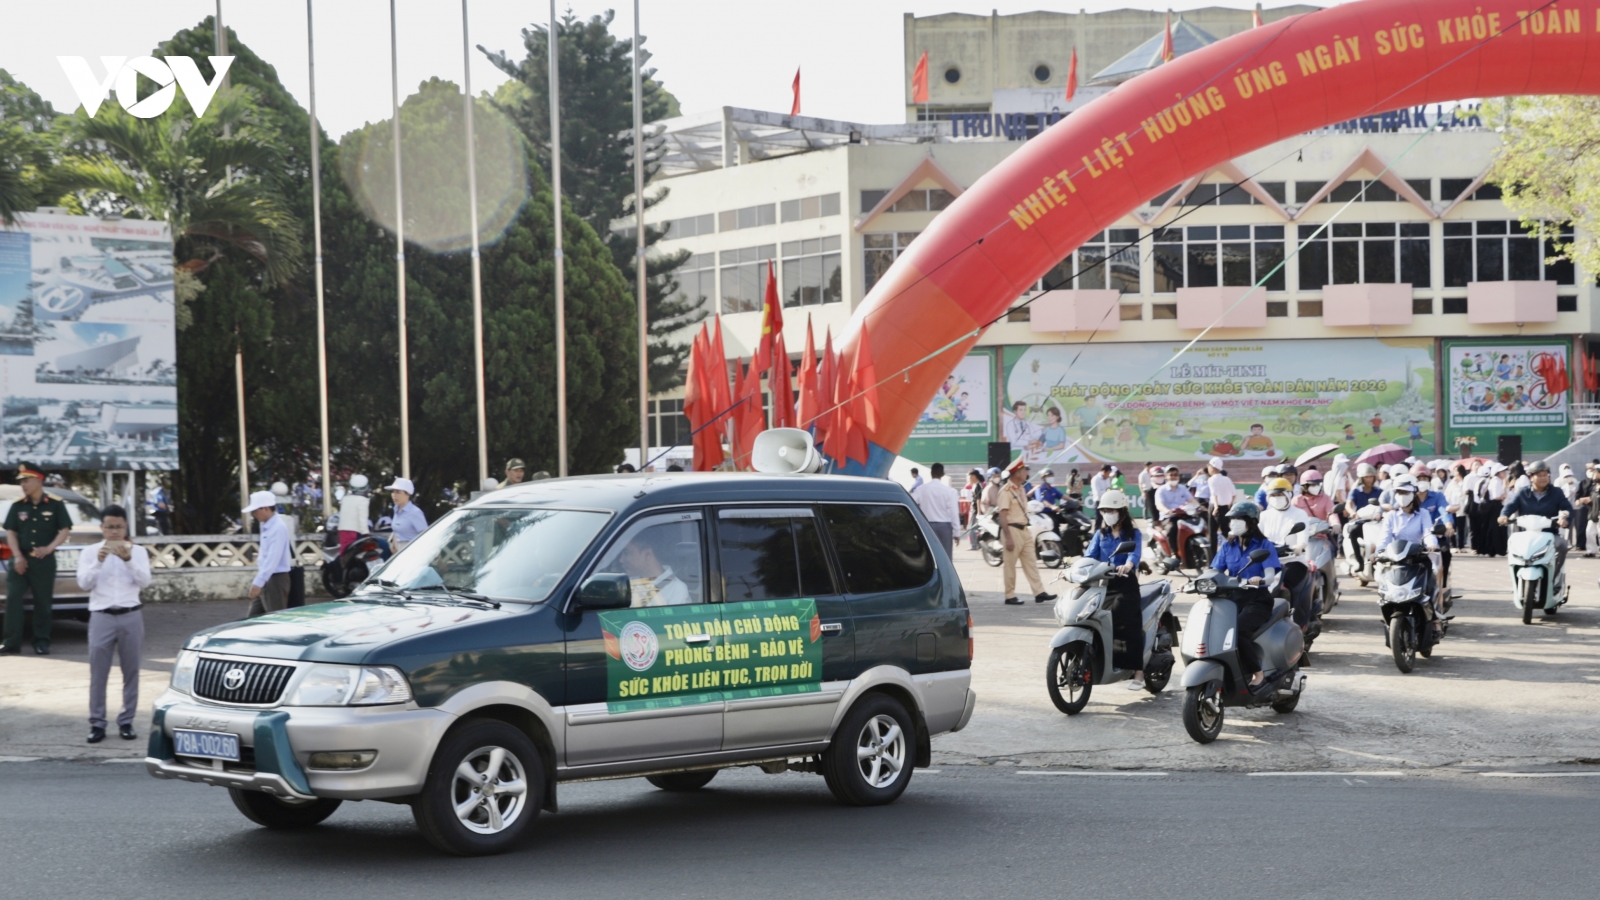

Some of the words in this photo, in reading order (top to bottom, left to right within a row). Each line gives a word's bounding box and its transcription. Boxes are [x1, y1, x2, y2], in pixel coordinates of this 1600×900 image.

[949, 112, 1027, 138] TRUNG
[1034, 106, 1074, 135] TÂ
[1008, 169, 1076, 231] NHIỆT
[1081, 132, 1134, 178] LIỆT
[1140, 86, 1226, 143] HƯỞNG
[1233, 61, 1288, 99] ỨNG
[1296, 35, 1362, 76] NGÀY
[1374, 21, 1425, 55] SỨC
[1438, 6, 1502, 44] KHỎE
[1516, 3, 1580, 35] TOÀN
[1193, 364, 1267, 378] MÍT-TINH
[1051, 382, 1088, 397] PHÁT
[1090, 382, 1130, 399] ĐỘNG
[1132, 380, 1171, 396] NGÀY
[1173, 380, 1201, 395] SỨC
[1204, 379, 1242, 394] KHỎE
[1244, 379, 1283, 393] TOÀN
[1286, 378, 1316, 392] DÂN
[1318, 378, 1348, 392] NĂM
[1350, 380, 1386, 392] 2026
[664, 621, 702, 640] TOÀN
[704, 618, 732, 636] DÂN
[734, 614, 762, 635] CHỦ
[764, 614, 800, 634] ĐỘNG
[665, 644, 712, 666] PHÒNG
[715, 642, 750, 663] BỆNH
[760, 638, 786, 658] BẢO
[788, 636, 804, 657] VỆ
[619, 676, 649, 698] SỨC
[652, 671, 688, 694] KHỎE
[692, 669, 720, 688] LIÊN
[723, 668, 752, 688] TỤC,
[754, 664, 788, 684] TRỌN
[790, 661, 812, 680] ĐỜI
[175, 732, 238, 758] 78A-00260
